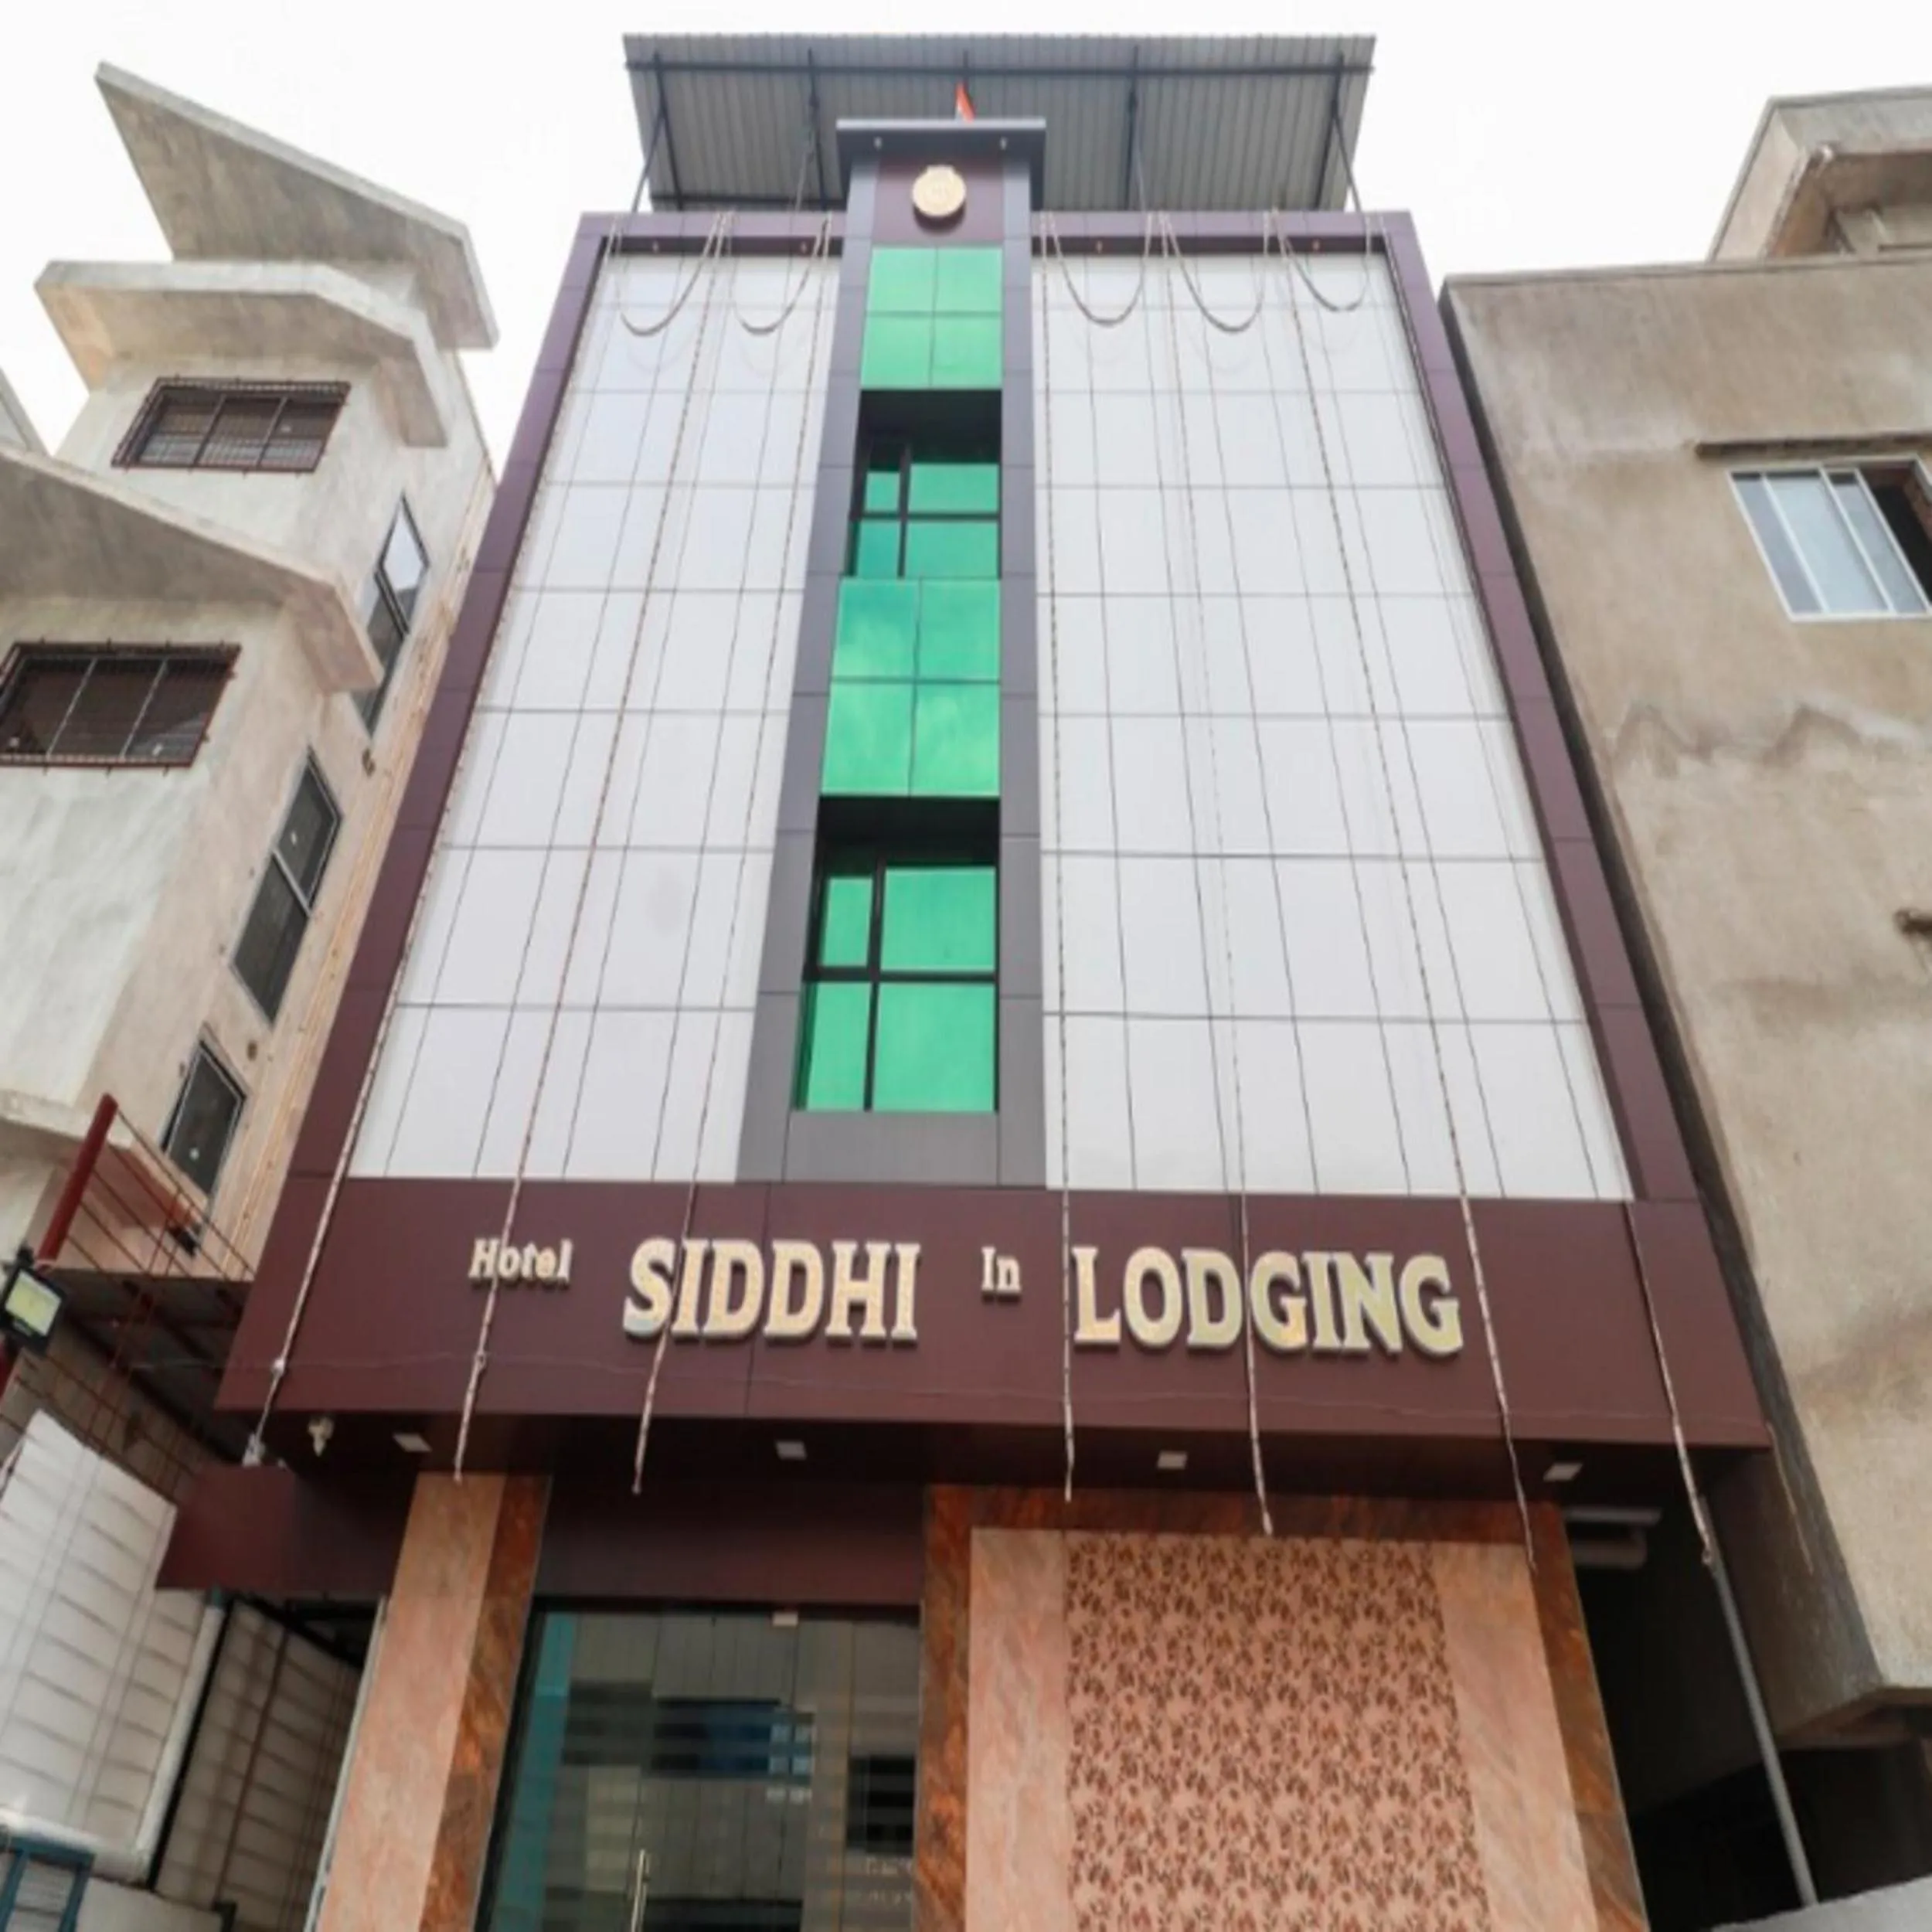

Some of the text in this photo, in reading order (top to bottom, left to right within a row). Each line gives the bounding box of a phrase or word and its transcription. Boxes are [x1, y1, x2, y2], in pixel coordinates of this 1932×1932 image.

[468, 1237, 1464, 1355] Hotel SIDDHI In LODGING
